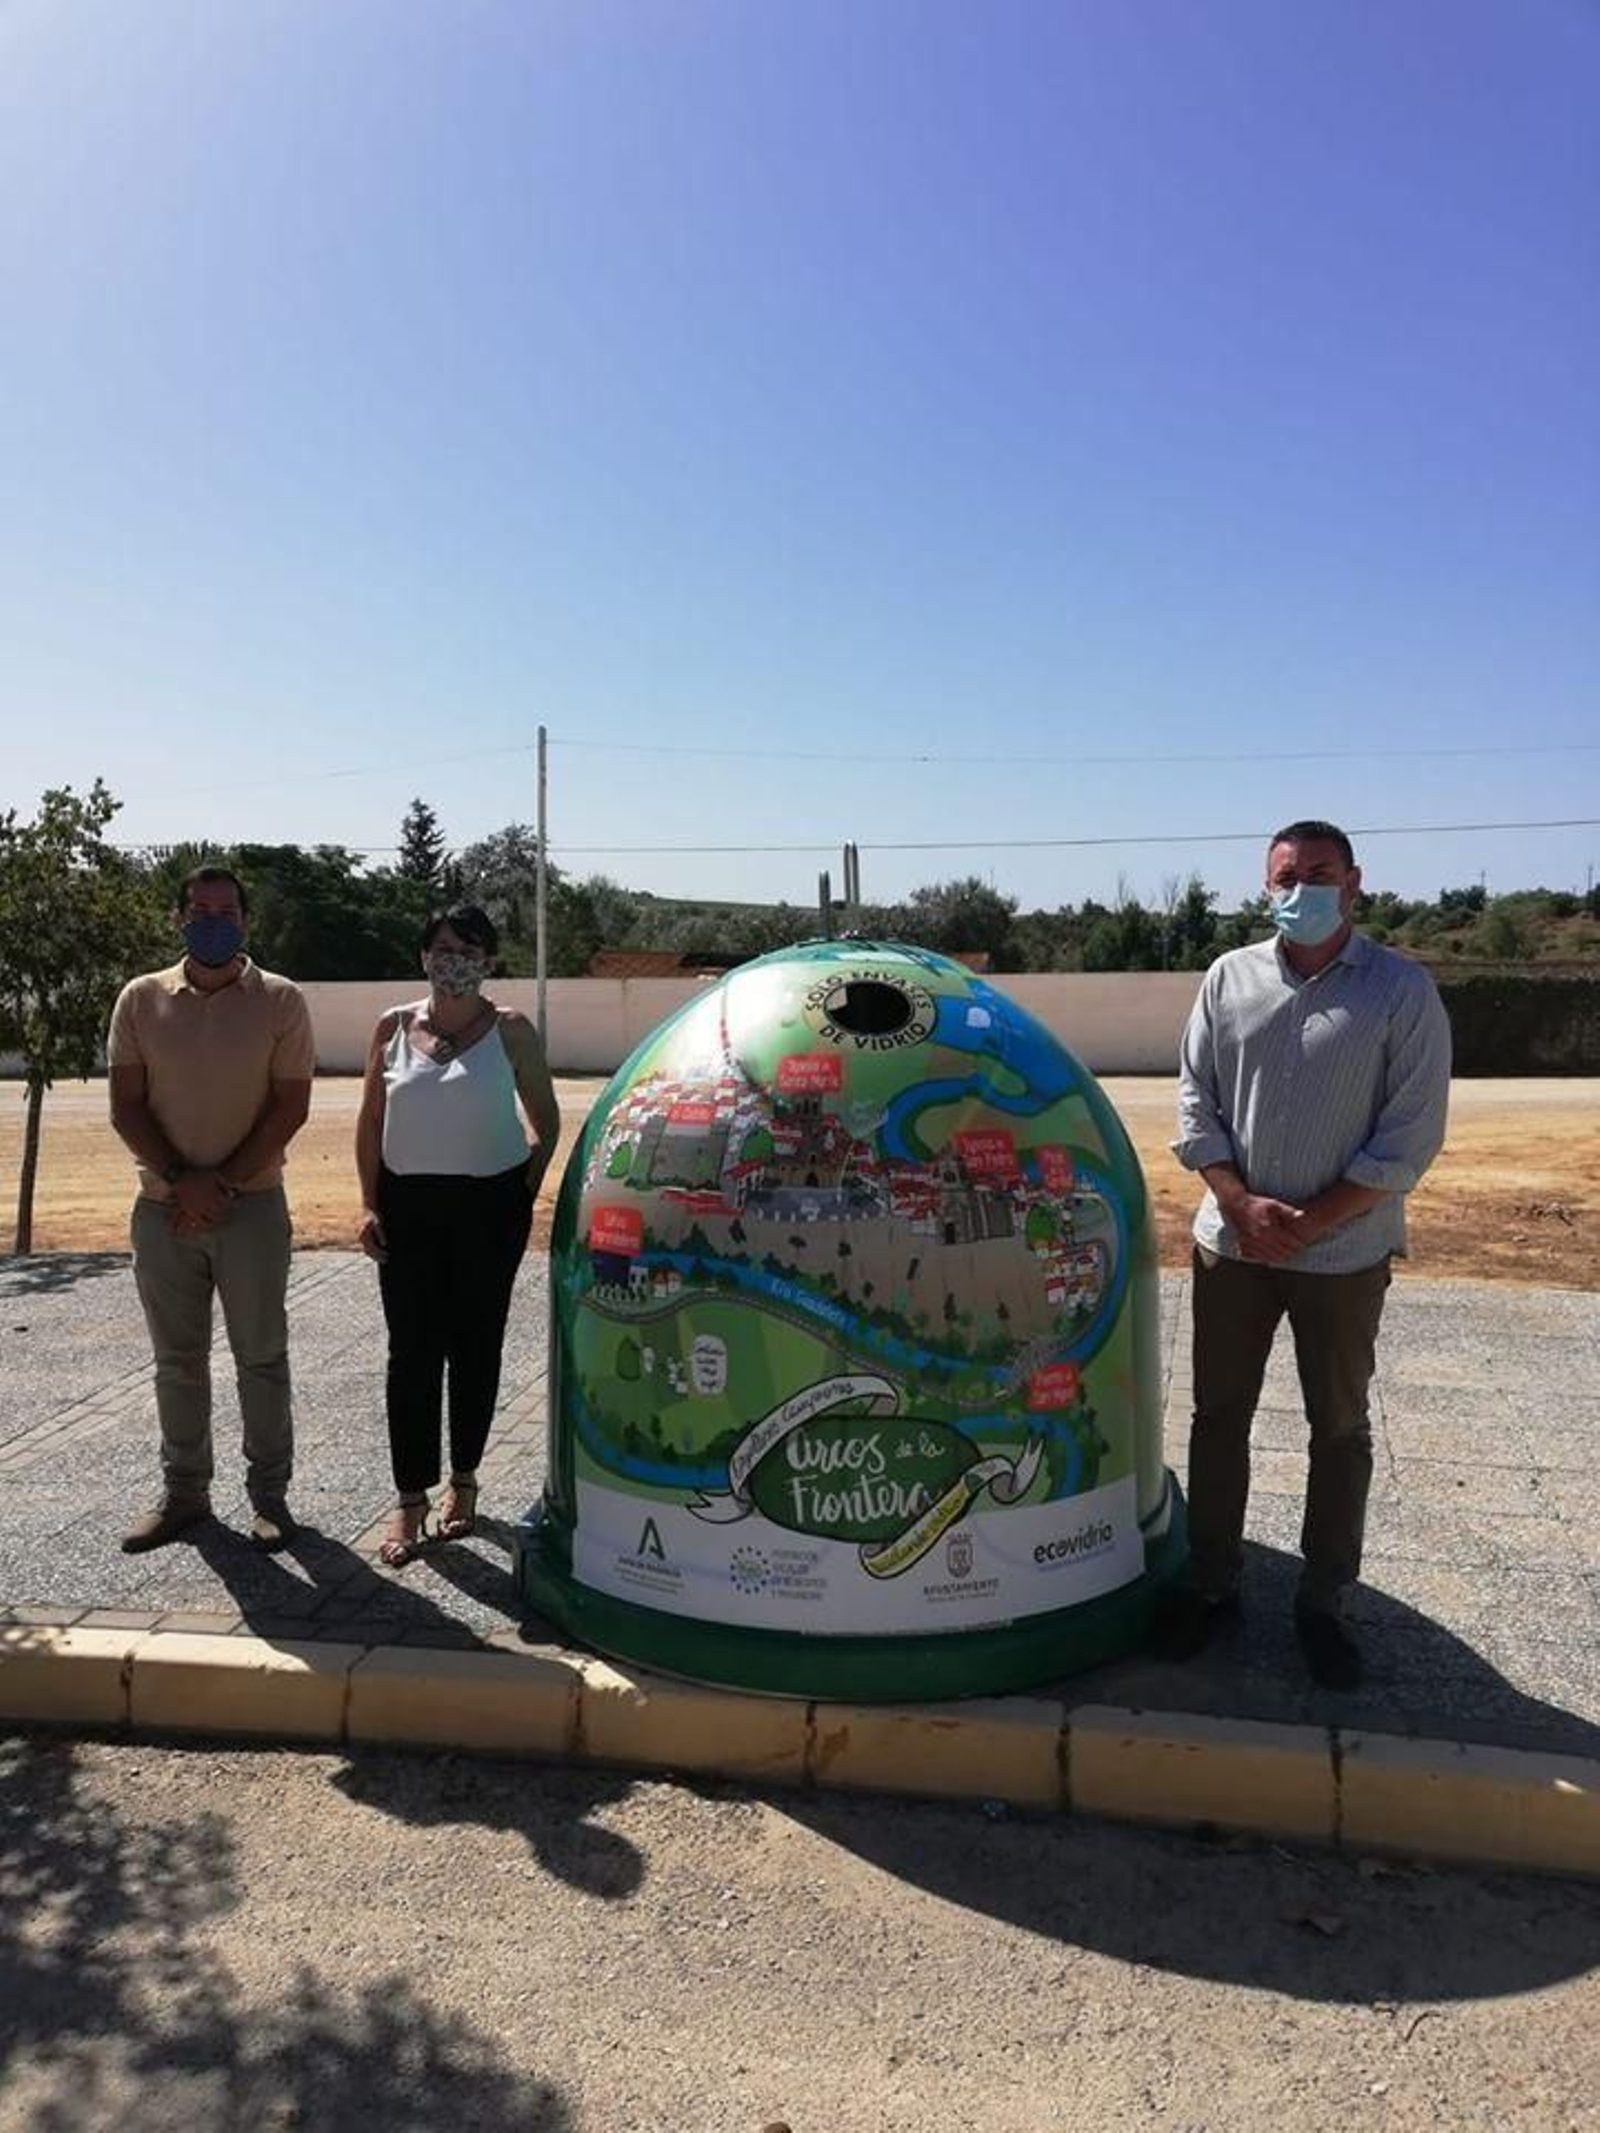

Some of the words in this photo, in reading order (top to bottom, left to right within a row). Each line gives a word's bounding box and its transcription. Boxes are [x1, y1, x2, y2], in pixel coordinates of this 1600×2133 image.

[806, 976, 842, 1011] SOLO
[819, 1024, 846, 1045] DE
[854, 1022, 928, 1051] VIDRIO
[918, 1430, 946, 1458] la
[1033, 1519, 1113, 1565] ecovidrio
